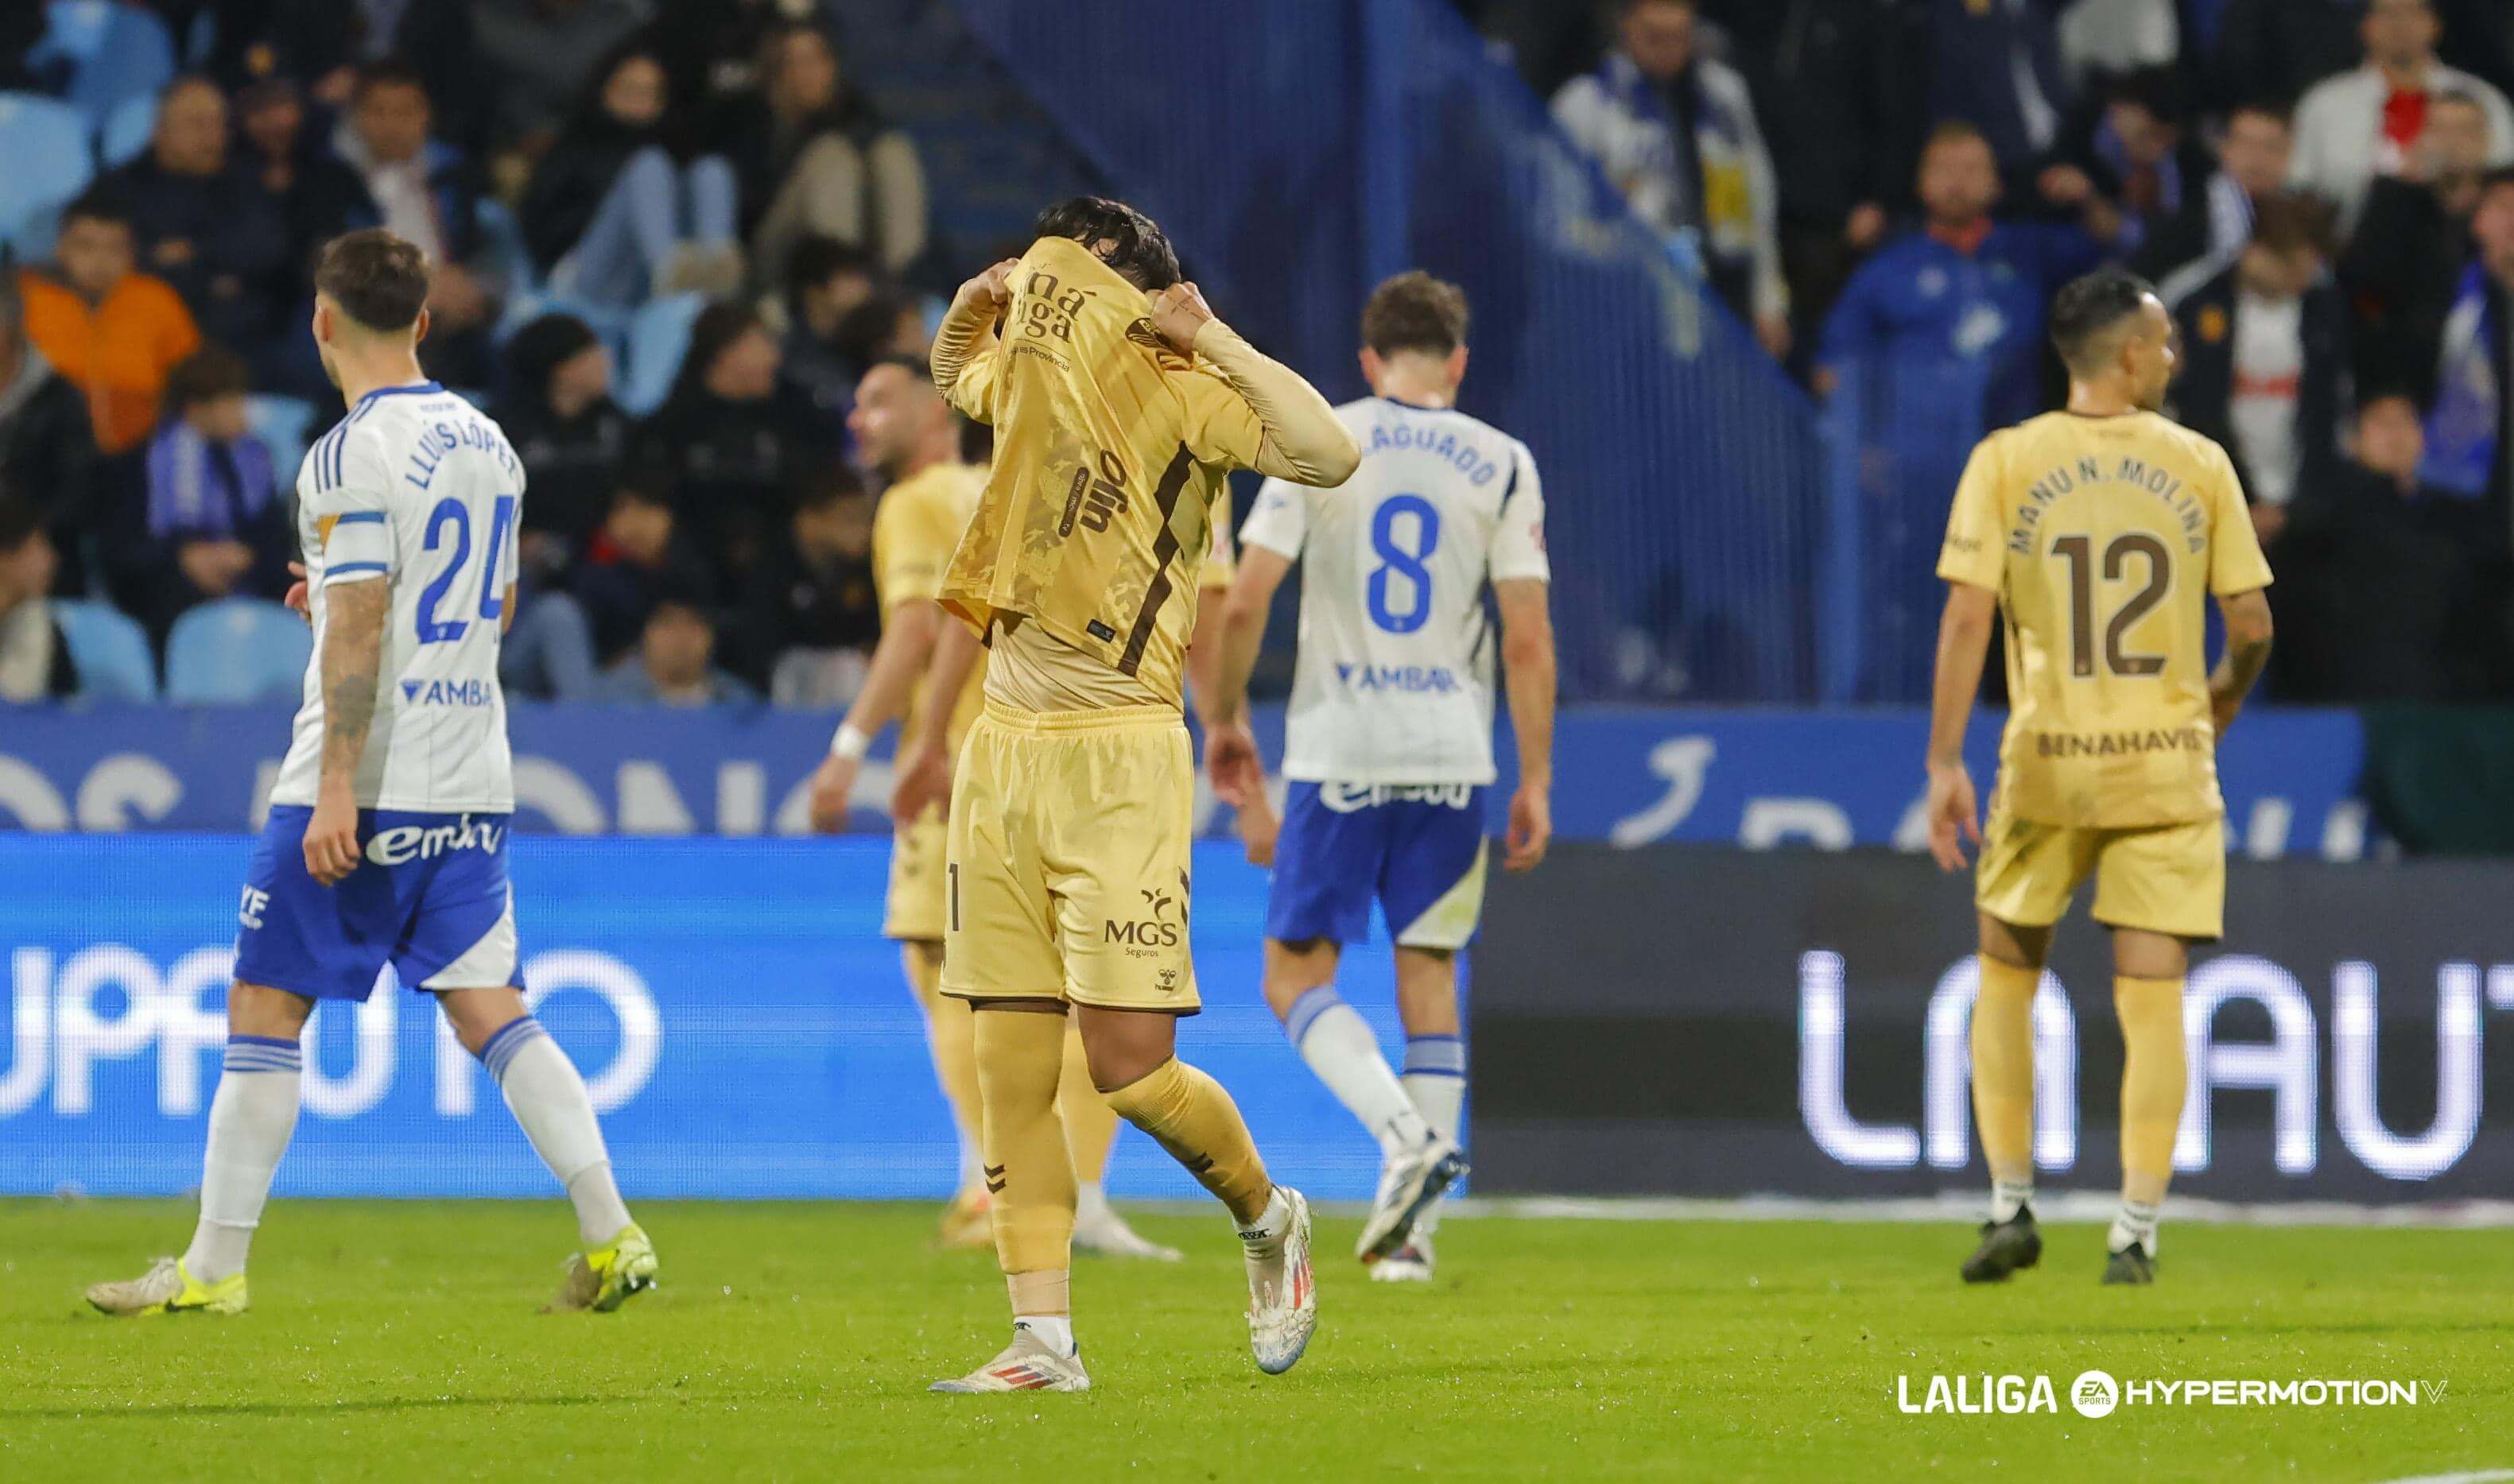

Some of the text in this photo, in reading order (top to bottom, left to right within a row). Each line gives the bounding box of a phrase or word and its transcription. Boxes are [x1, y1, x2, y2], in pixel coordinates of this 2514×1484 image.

[1371, 423, 1497, 487] AGUADO
[2008, 467, 2074, 556] MANU
[2116, 455, 2209, 556] MOLINA
[1368, 494, 1439, 634] 8
[2050, 533, 2172, 678] 12
[949, 862, 960, 932] 1
[1104, 919, 1178, 947] MGS
[1125, 947, 1159, 959] Seguros
[1795, 949, 2514, 1181] LA AU
